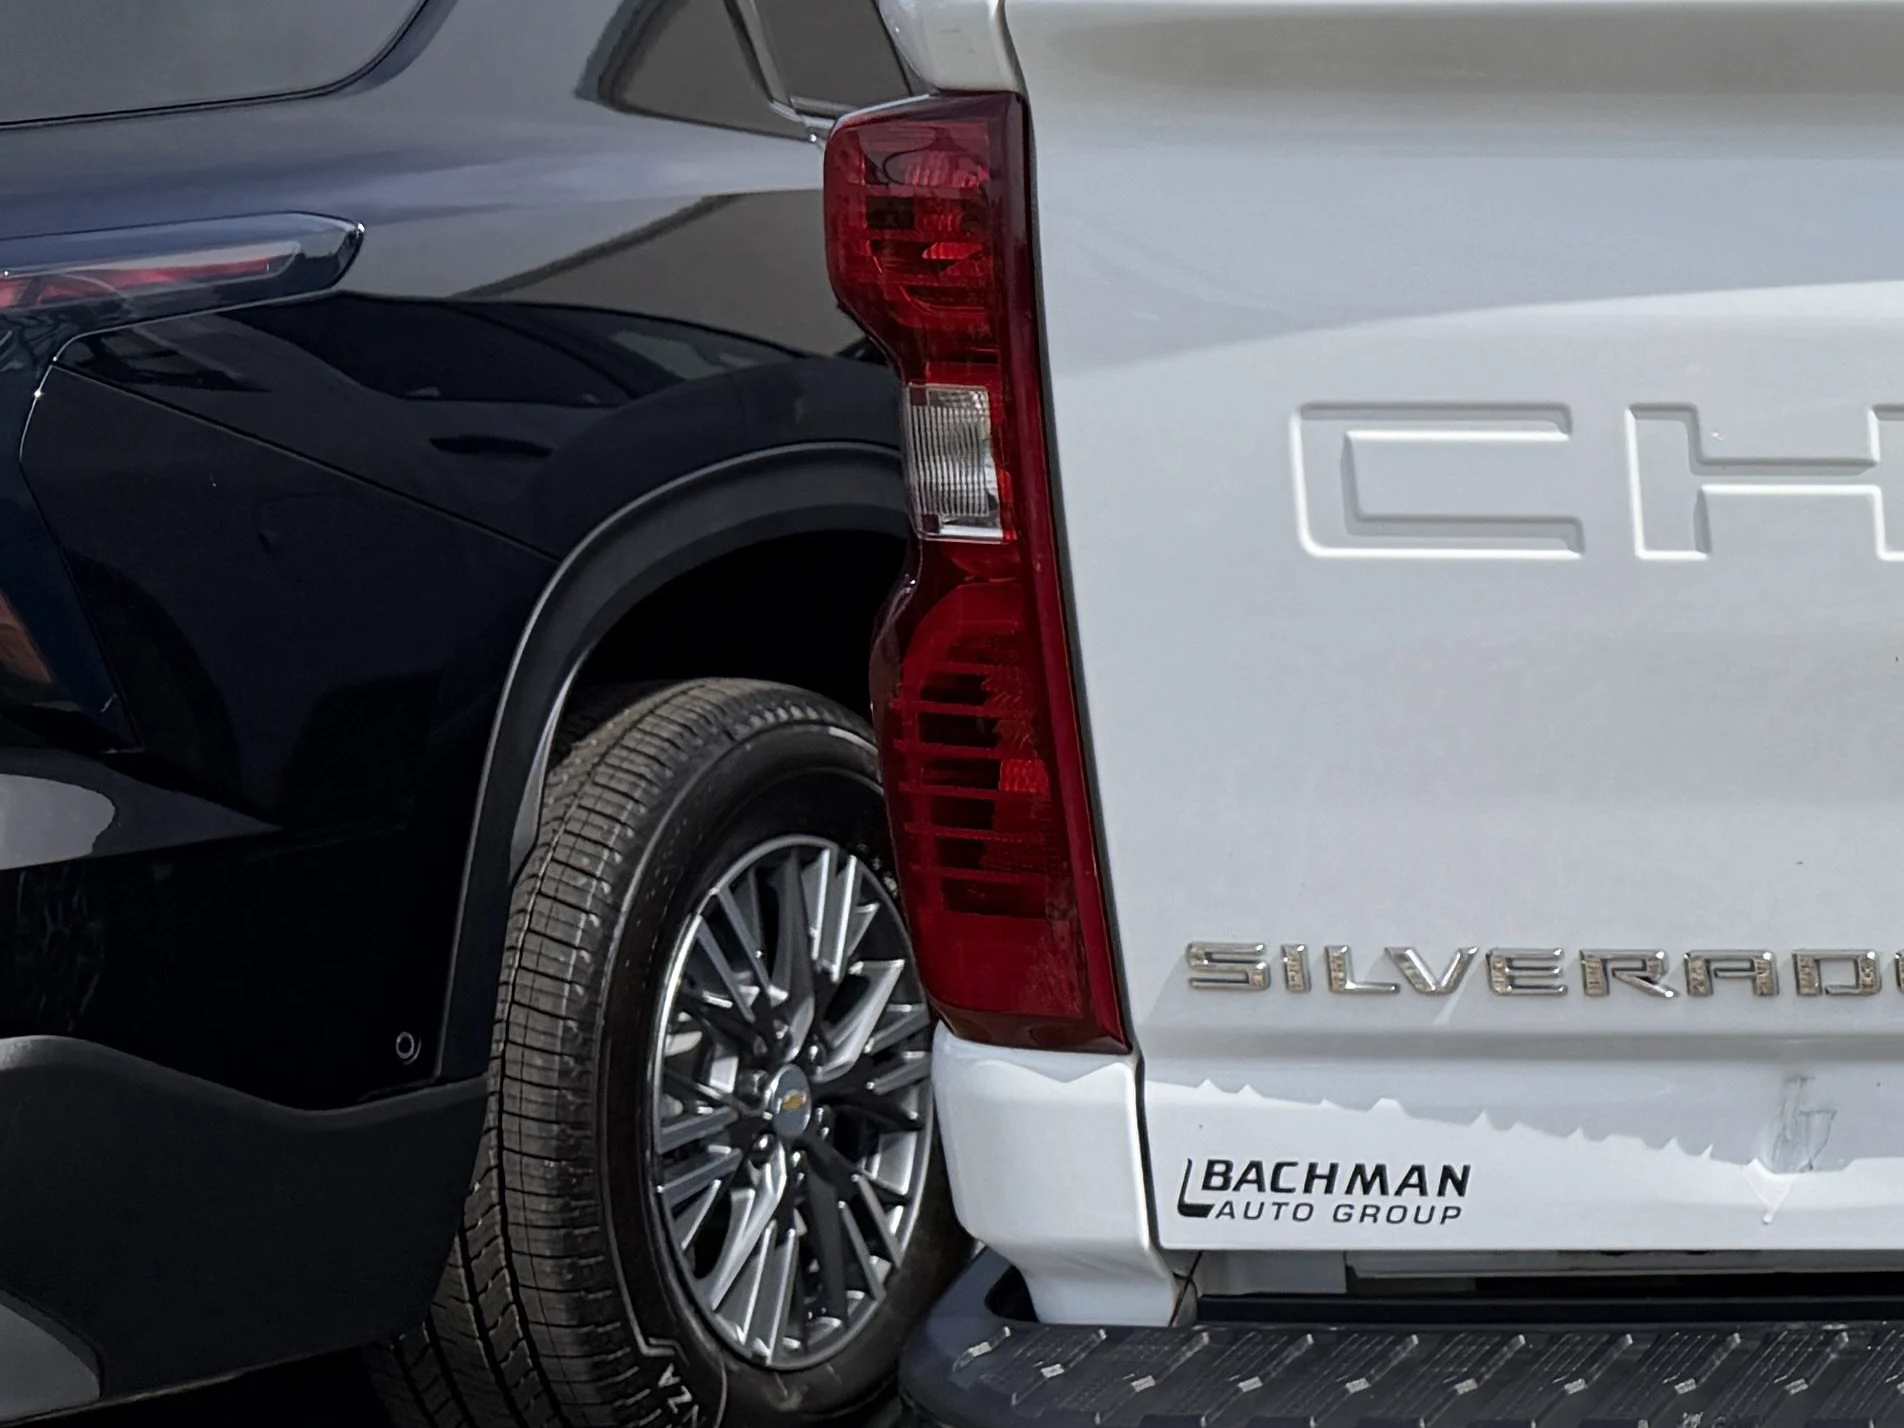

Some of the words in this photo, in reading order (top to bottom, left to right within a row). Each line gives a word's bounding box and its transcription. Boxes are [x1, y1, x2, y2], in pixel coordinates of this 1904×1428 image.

[1201, 1159, 1471, 1197] BACHMAN
[1214, 1201, 1314, 1223] AUTO
[1331, 1204, 1464, 1226] GROUP
